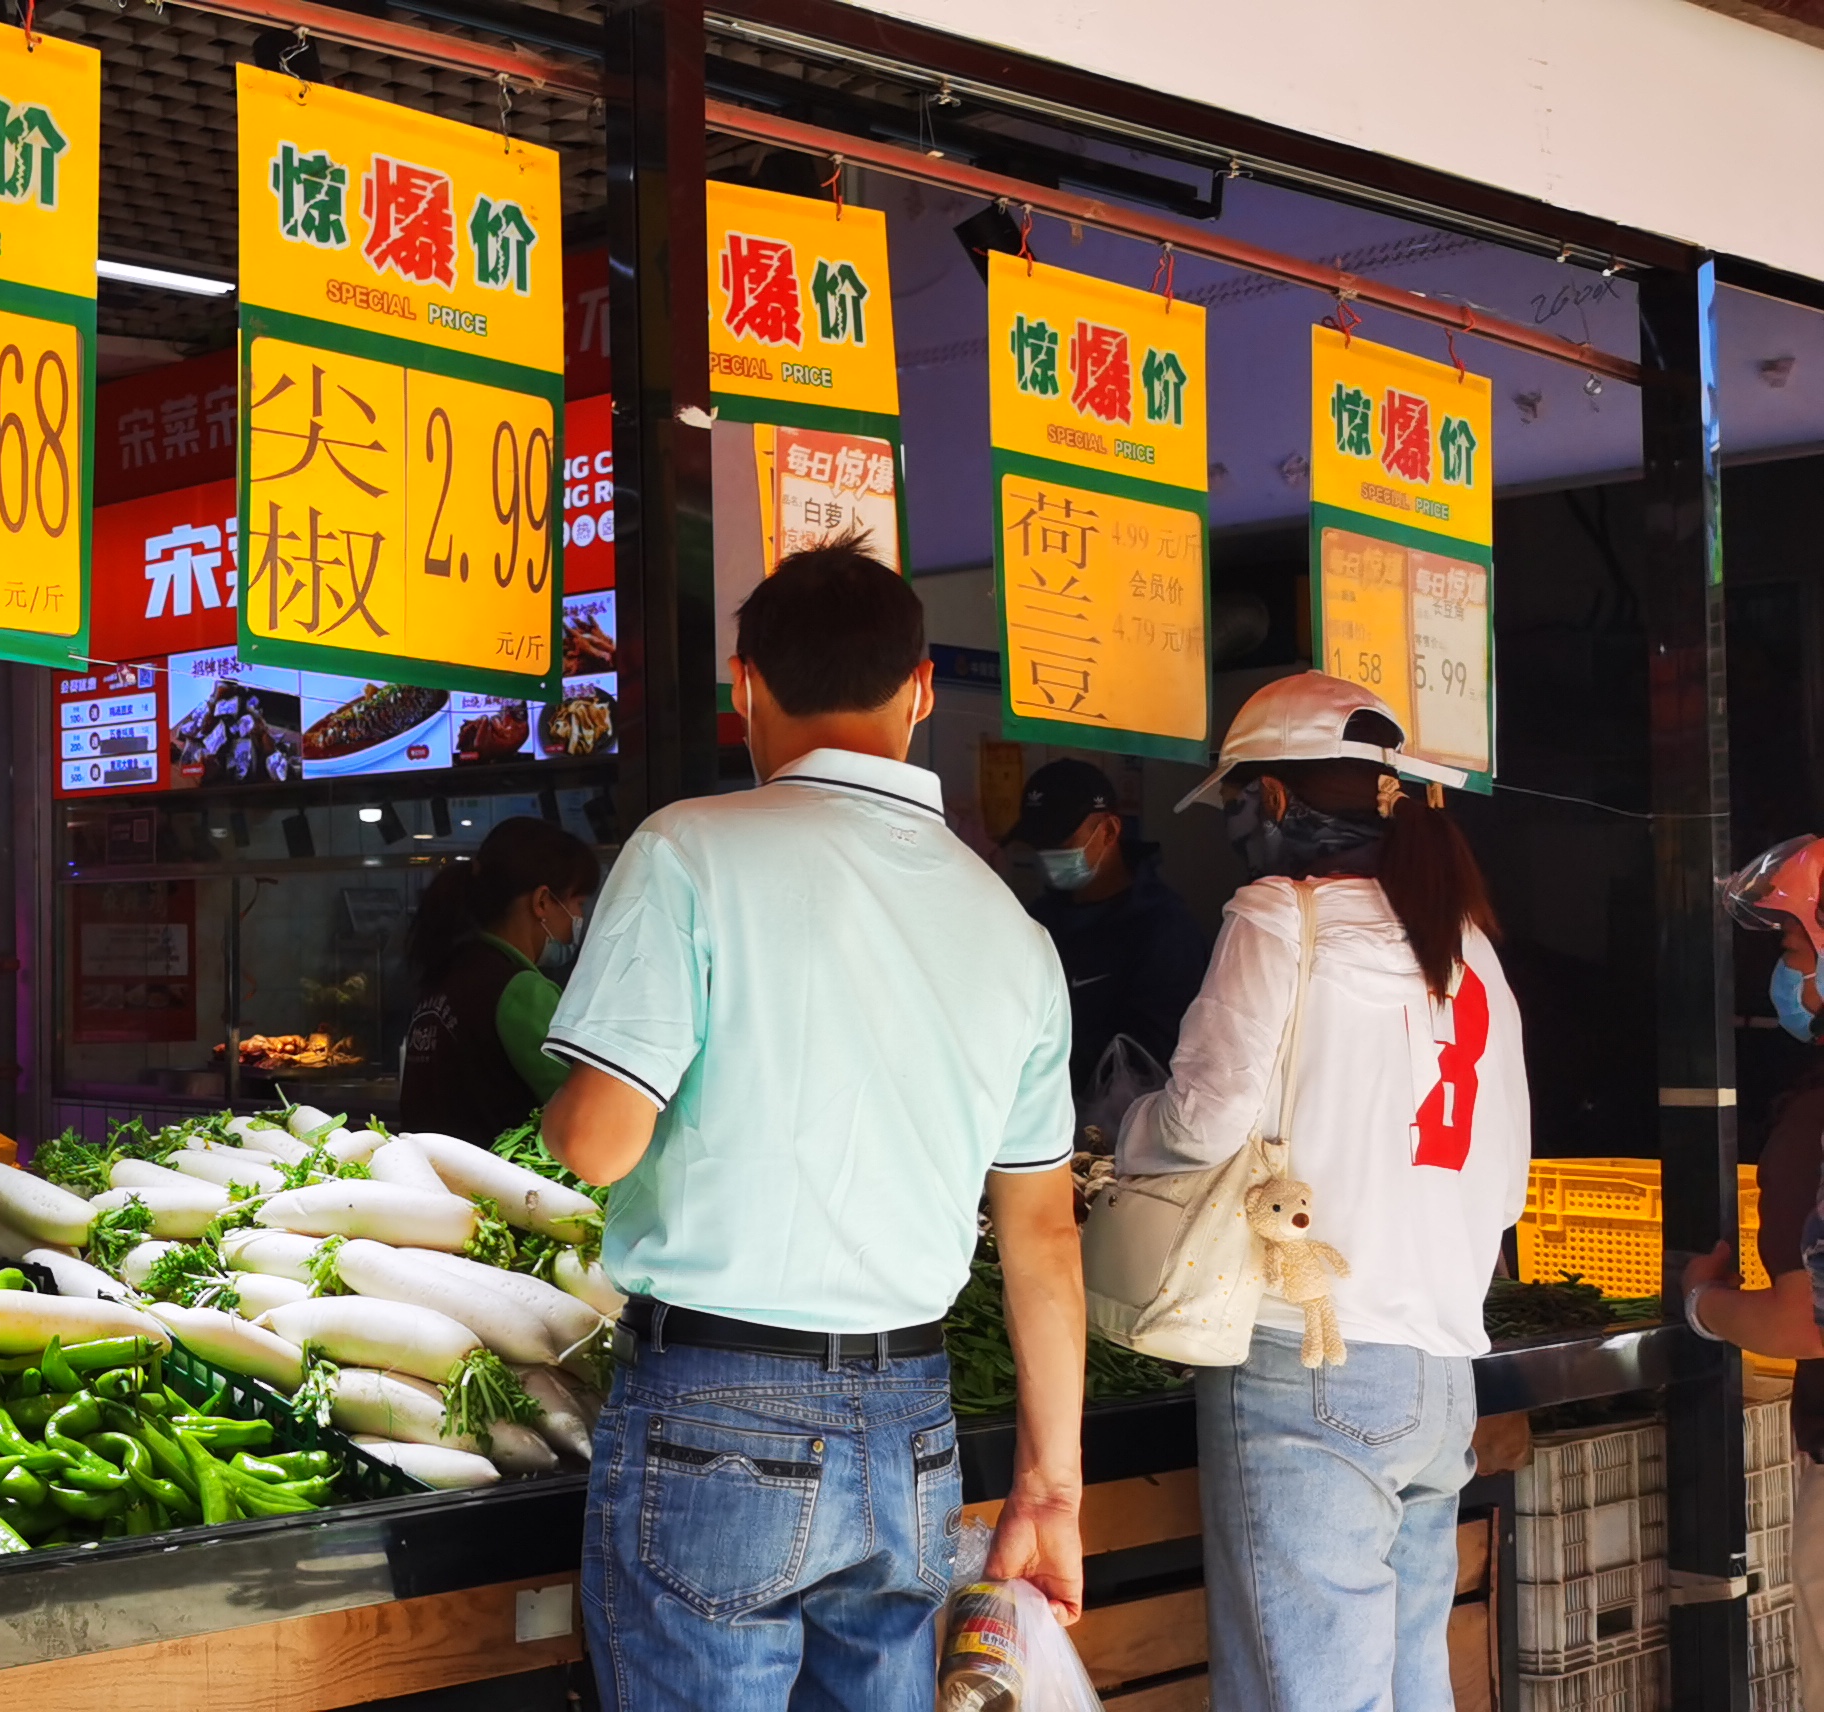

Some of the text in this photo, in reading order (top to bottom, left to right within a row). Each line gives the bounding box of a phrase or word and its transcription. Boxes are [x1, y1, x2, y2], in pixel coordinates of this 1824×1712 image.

[268, 140, 538, 297] 惊爆价
[326, 280, 488, 337] SPECIAL PRICE
[718, 229, 871, 351] 爆价
[709, 352, 833, 388] PECIAL PRICE
[1009, 311, 1188, 430] 惊爆价
[1047, 423, 1156, 464] SPECIAL PRICE
[1330, 379, 1479, 490] 惊爆价
[787, 442, 895, 502] 每日惊爆
[247, 362, 391, 638] 尖椒
[423, 406, 554, 594] 2.99
[803, 496, 865, 532] 白萝卜
[1414, 495, 1450, 521] PRICE
[1111, 520, 1201, 562] 4.99 元/斤
[145, 516, 237, 619] 宋
[1128, 569, 1184, 606] 会员价
[4, 580, 65, 614] 元/斤
[1006, 490, 1109, 722] 荷兰豆
[495, 631, 545, 661] 元/斤
[1112, 612, 1155, 646] 4.79
[1332, 647, 1383, 685] 1.58
[1413, 652, 1468, 698] 5.99
